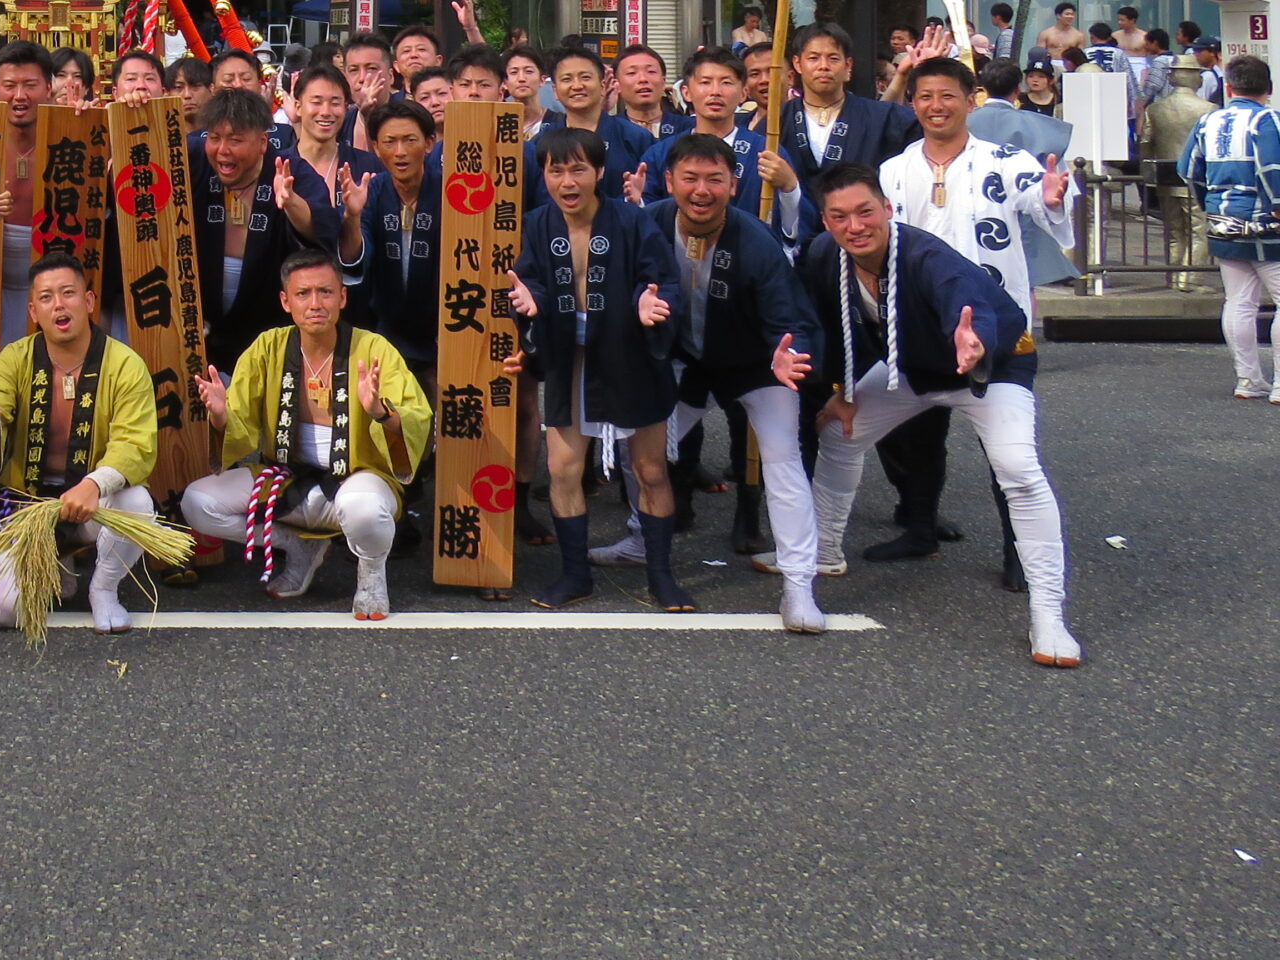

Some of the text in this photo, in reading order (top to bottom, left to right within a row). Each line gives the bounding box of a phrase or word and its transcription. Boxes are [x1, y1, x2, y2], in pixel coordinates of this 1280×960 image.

[1254, 16, 1264, 34] 3
[1227, 43, 1248, 56] 1914
[83, 124, 107, 290] 公益社団法
